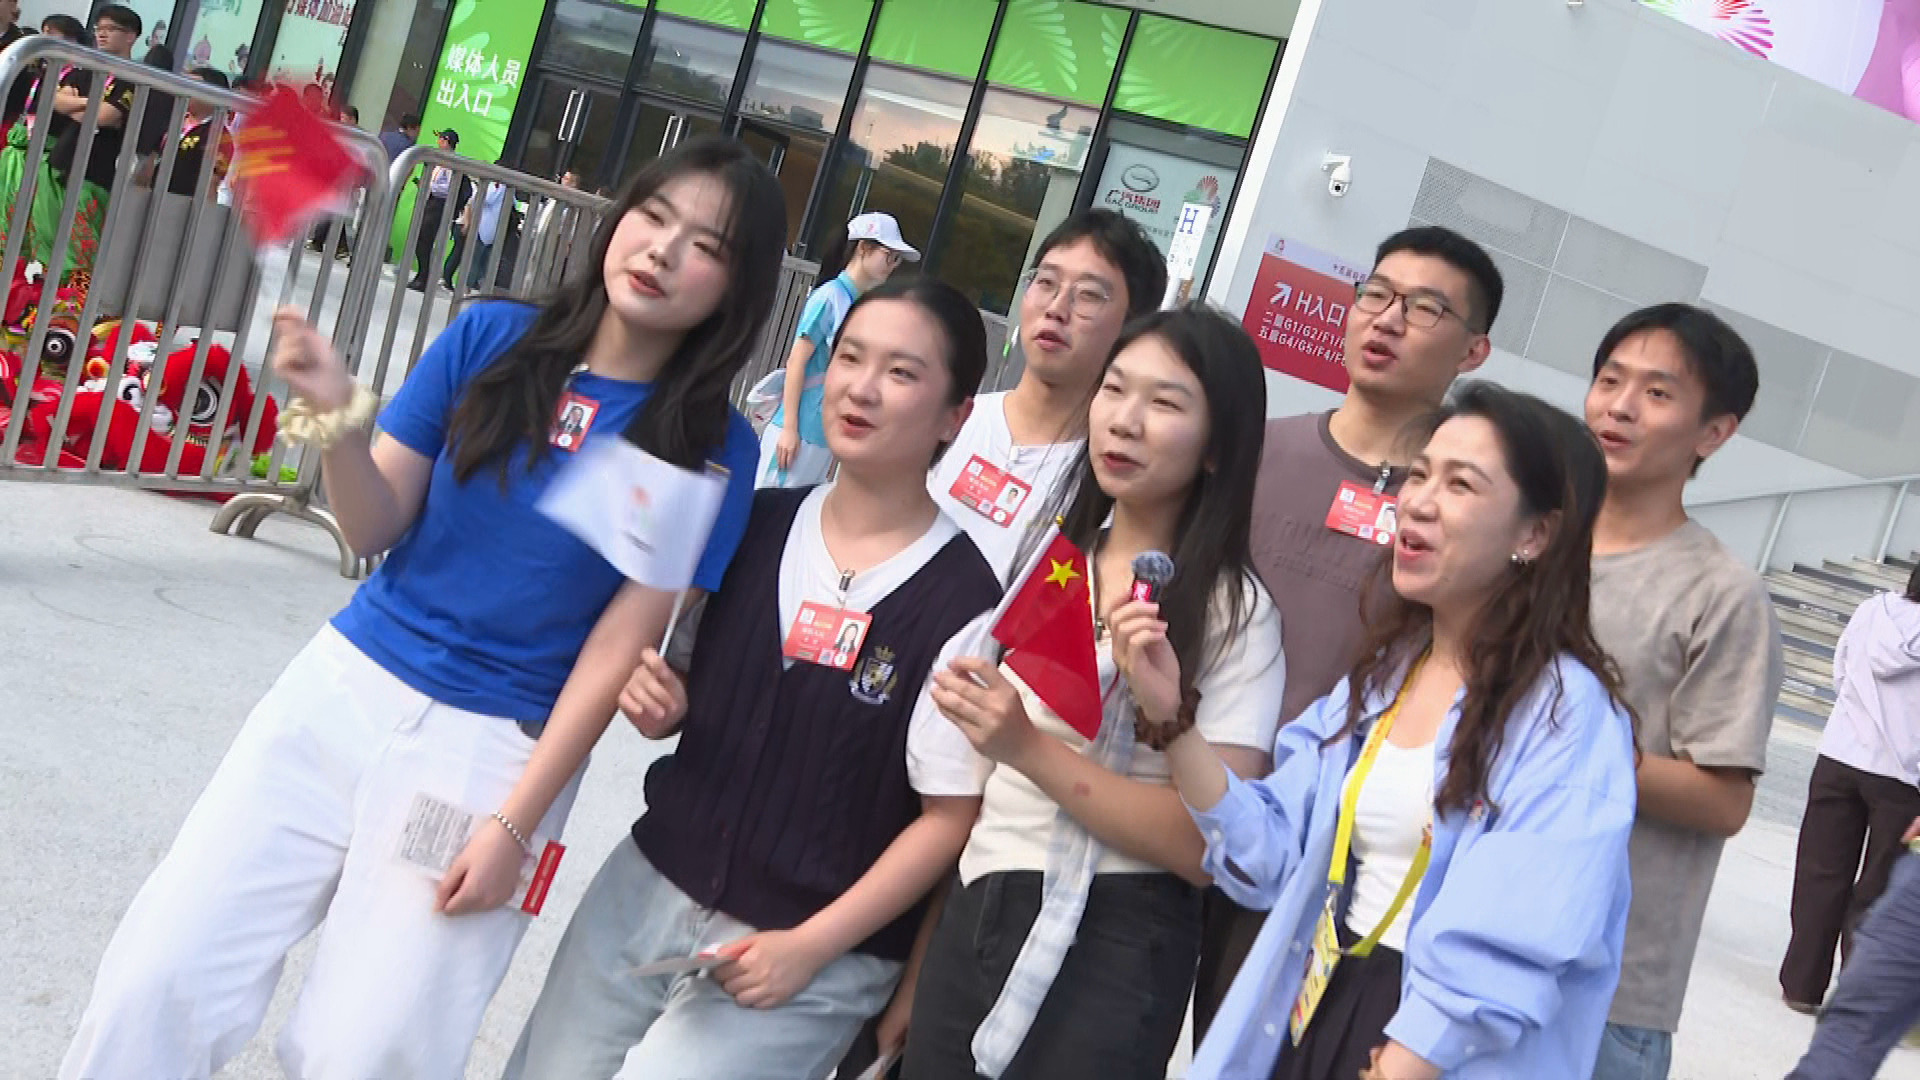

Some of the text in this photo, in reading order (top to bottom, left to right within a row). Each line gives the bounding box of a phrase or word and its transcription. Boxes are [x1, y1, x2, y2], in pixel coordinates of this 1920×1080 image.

[445, 43, 521, 89] 媒体人员
[436, 77, 493, 117] 出入口
[1105, 189, 1161, 209] 广汽集团
[1179, 207, 1199, 234] H
[1295, 289, 1347, 328] H入口
